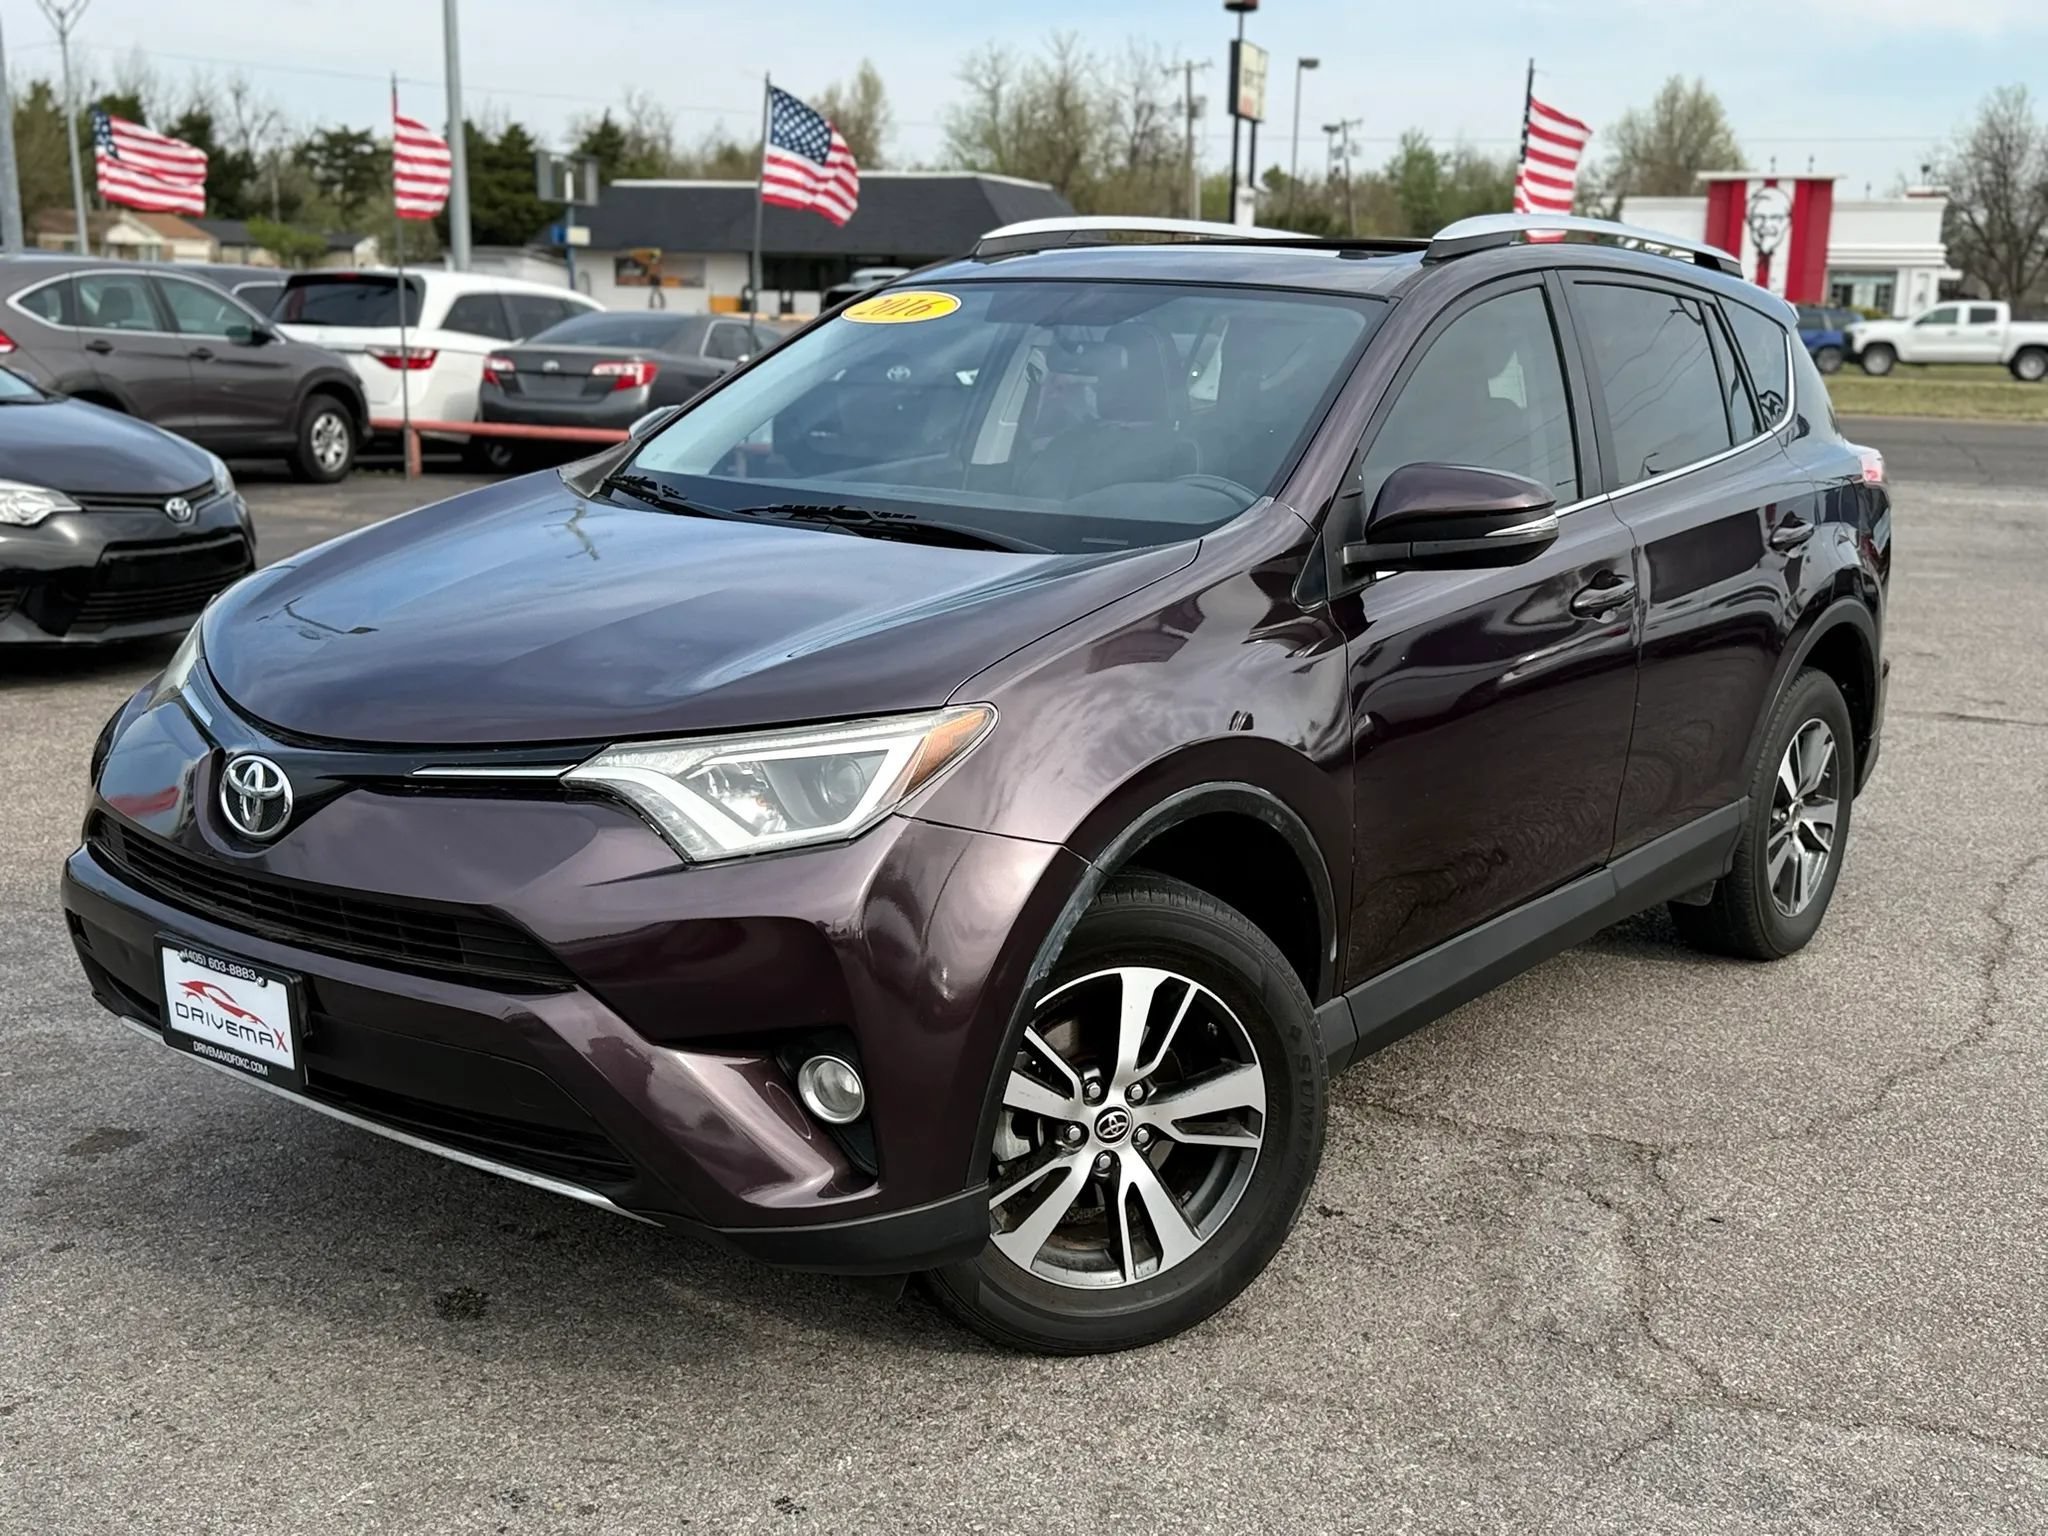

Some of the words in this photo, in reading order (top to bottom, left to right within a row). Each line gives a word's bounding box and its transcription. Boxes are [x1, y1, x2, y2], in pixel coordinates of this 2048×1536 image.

[851, 298, 949, 317] 2016
[184, 949, 207, 966] (405)
[207, 957, 257, 981] 603-8883
[175, 1001, 288, 1053] DRIVEMAX
